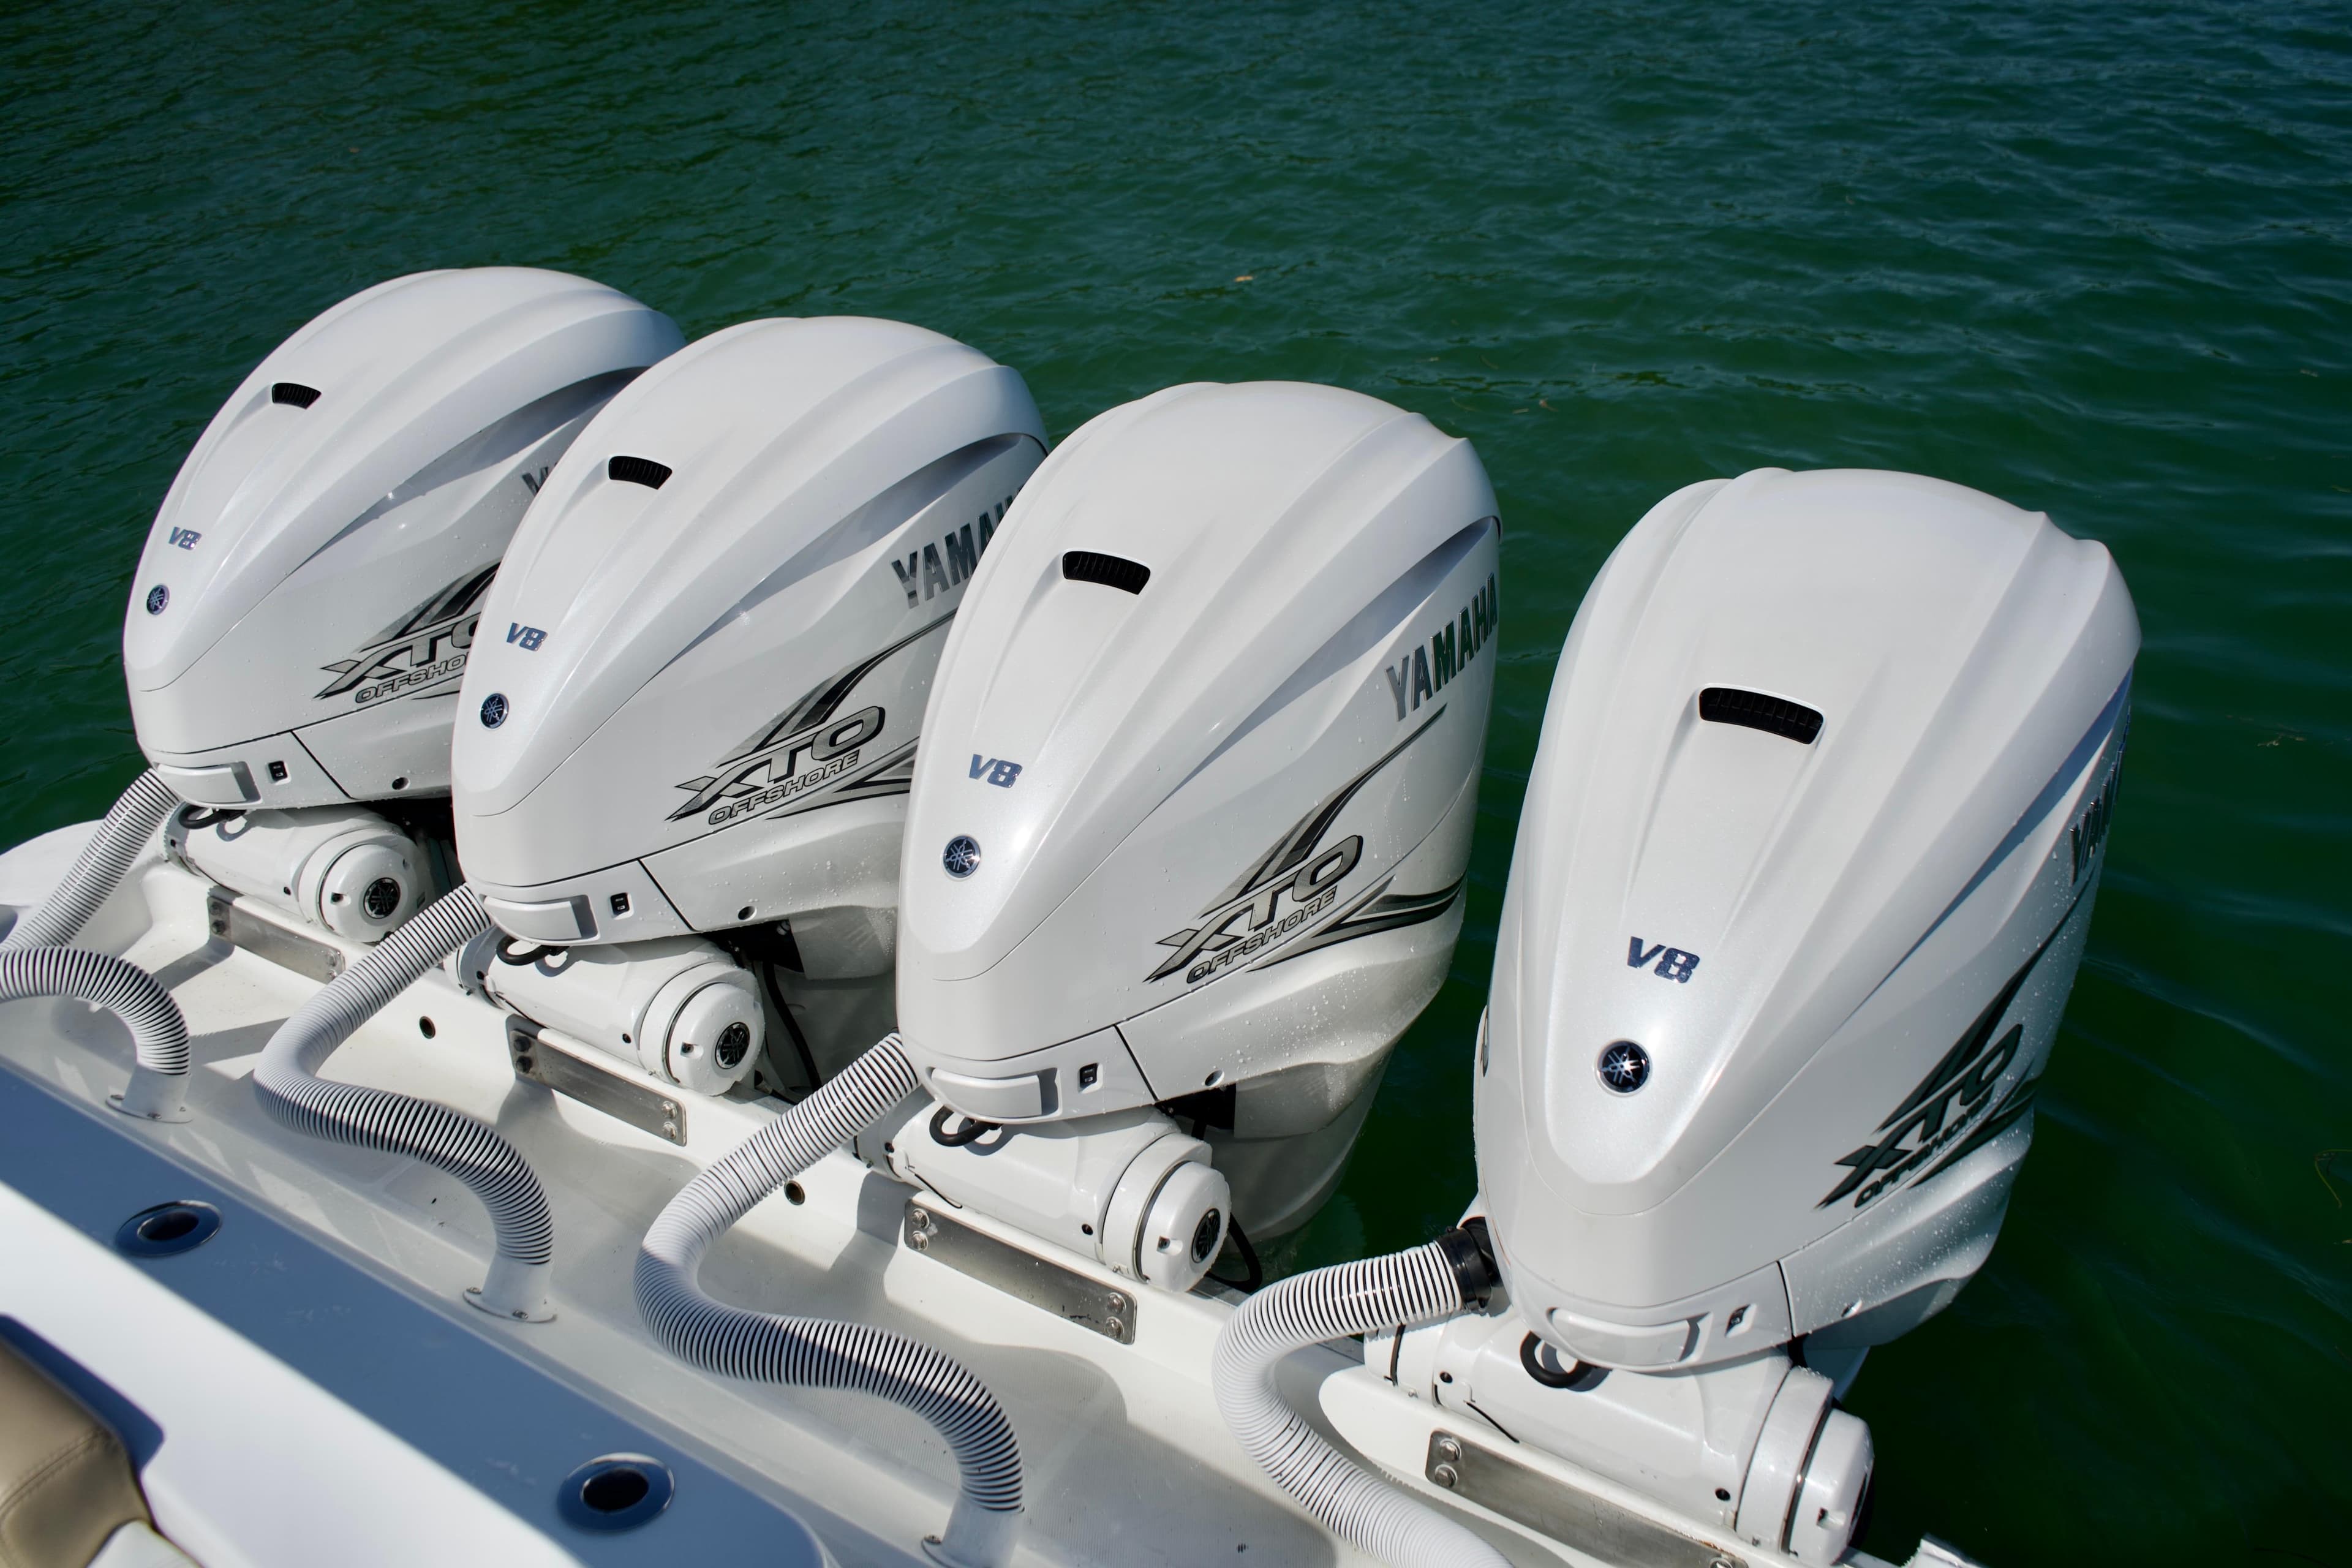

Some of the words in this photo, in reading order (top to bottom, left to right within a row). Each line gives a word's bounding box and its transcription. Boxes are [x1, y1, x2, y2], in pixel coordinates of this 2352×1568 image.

[168, 527, 202, 550] V8
[891, 483, 1027, 609] YAMA
[355, 650, 470, 703] OFFSHO
[507, 622, 548, 651] V8
[1384, 572, 1498, 722] YAMAHA
[665, 706, 886, 822] XTO
[709, 748, 860, 825] OFFSHORE
[969, 753, 1023, 788] V8
[1142, 835, 1363, 983] XTO
[1186, 885, 1338, 984] OFFSHORE
[1627, 936, 1700, 983] V8
[1814, 1024, 2023, 1210] XTO
